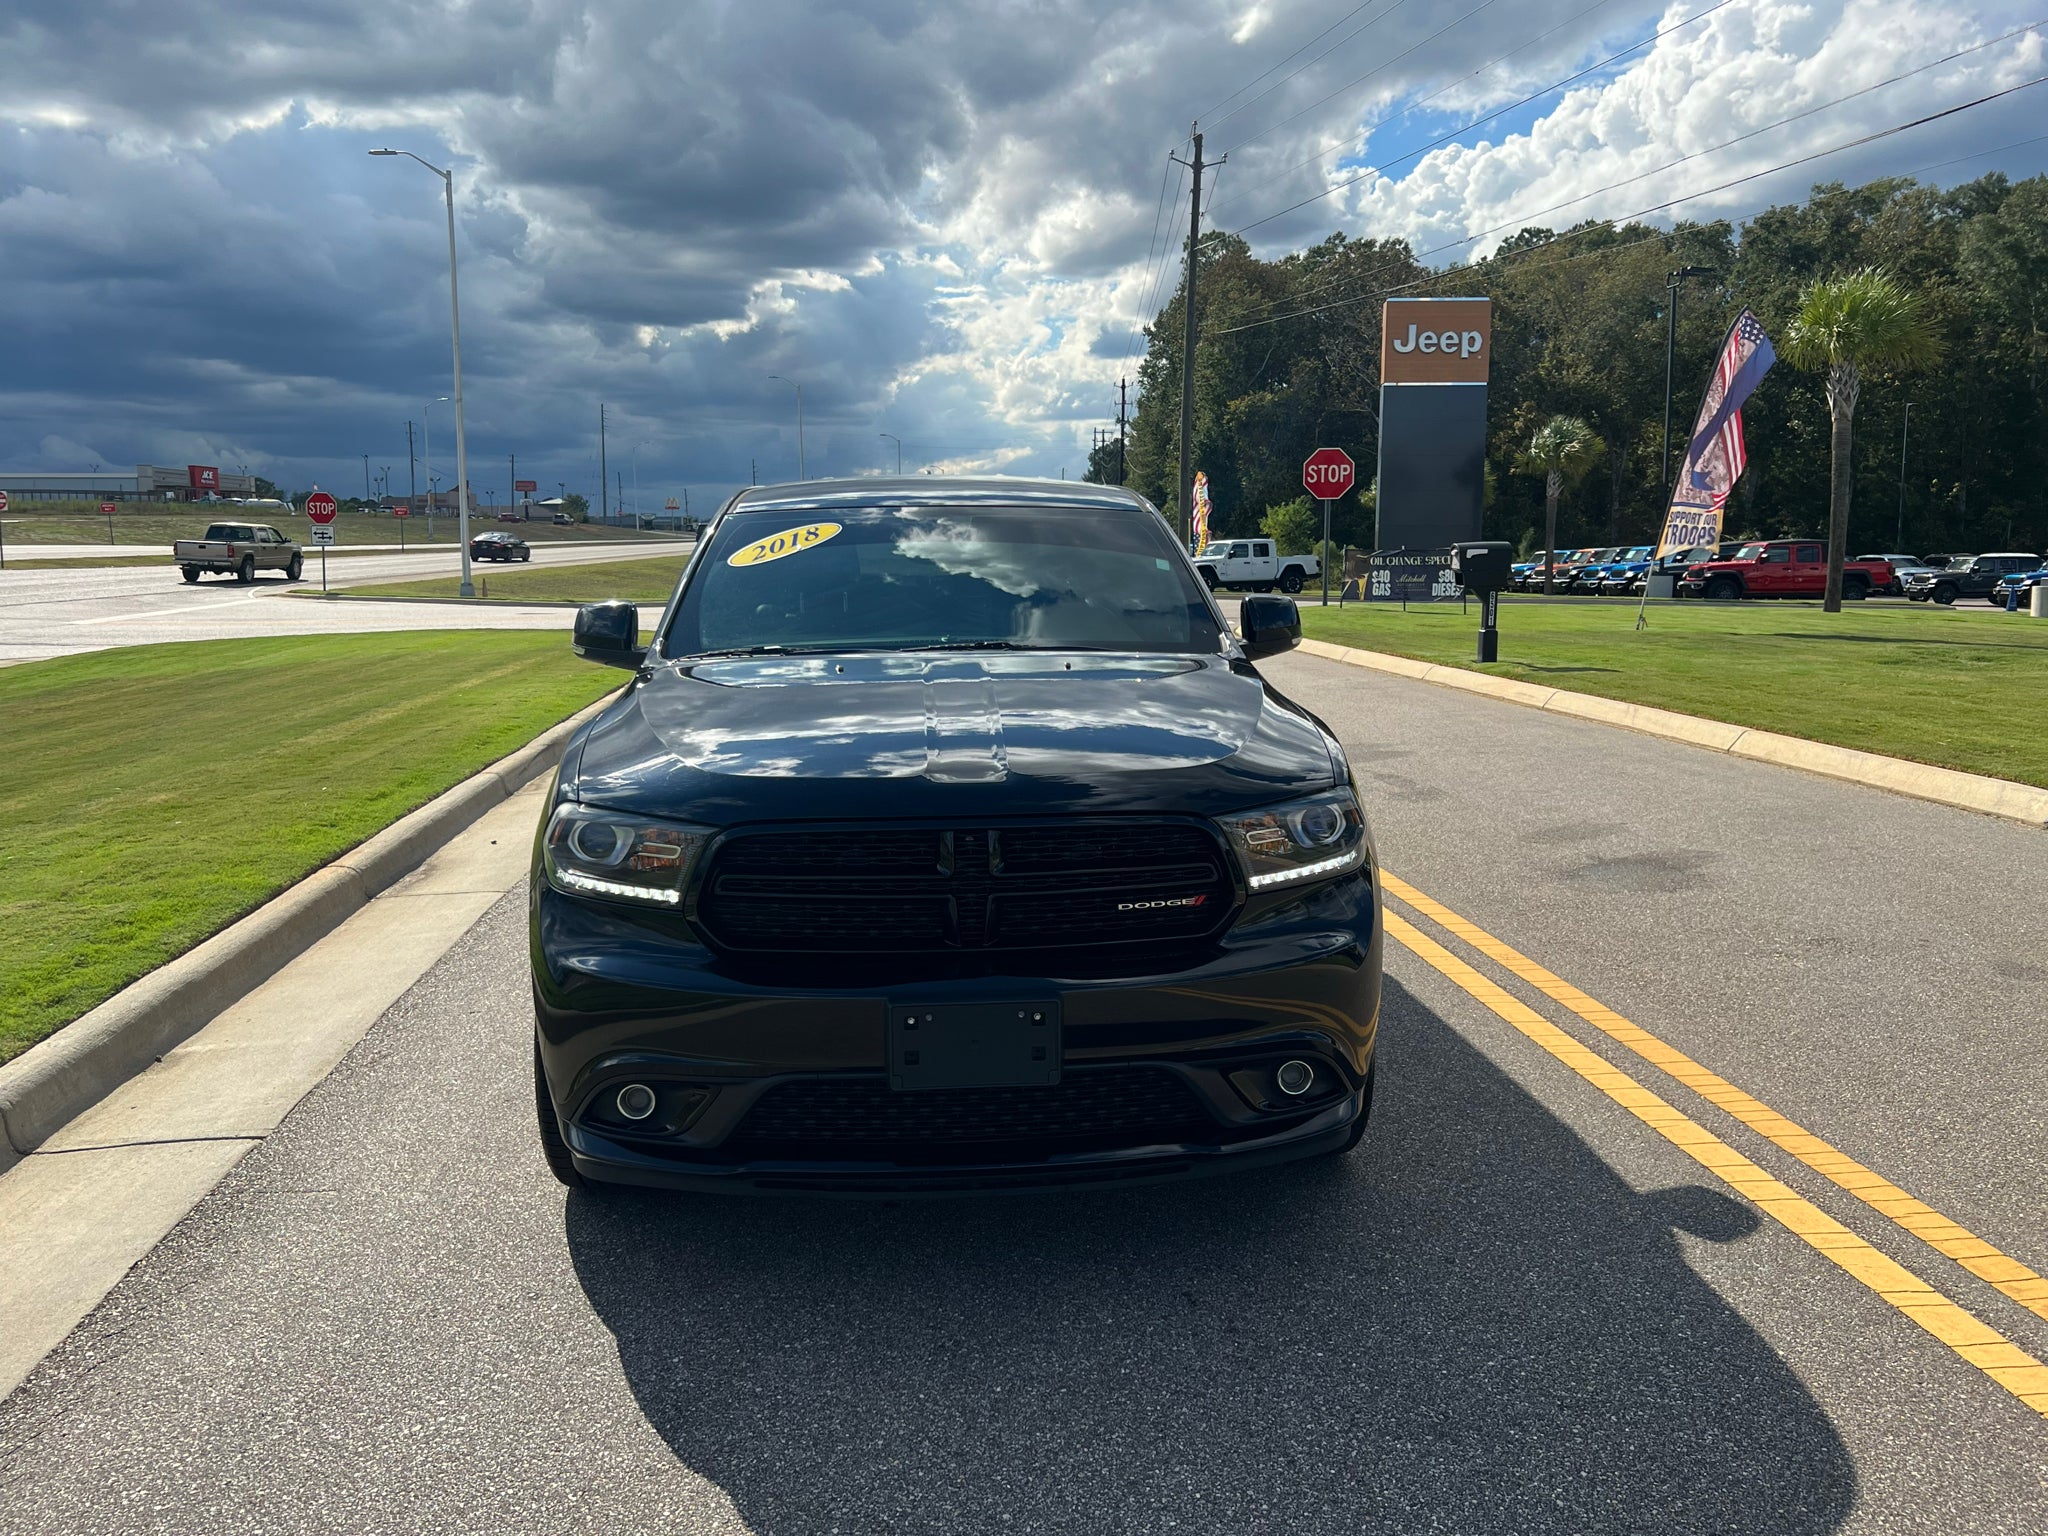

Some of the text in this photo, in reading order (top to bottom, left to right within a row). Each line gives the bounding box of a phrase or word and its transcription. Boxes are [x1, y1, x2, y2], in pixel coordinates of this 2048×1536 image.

[1393, 324, 1482, 358] Jeep
[1307, 464, 1351, 483] STOP
[308, 502, 335, 515] STOP
[1669, 511, 1718, 526] SUPPORT OUR
[1664, 525, 1715, 545] TROOPS
[752, 526, 819, 562] 2018
[1370, 555, 1451, 566] OIL CHANGE SPECI
[1371, 569, 1455, 583] $40 $80
[1372, 583, 1391, 596] GAS
[1118, 898, 1195, 910] DODGE
